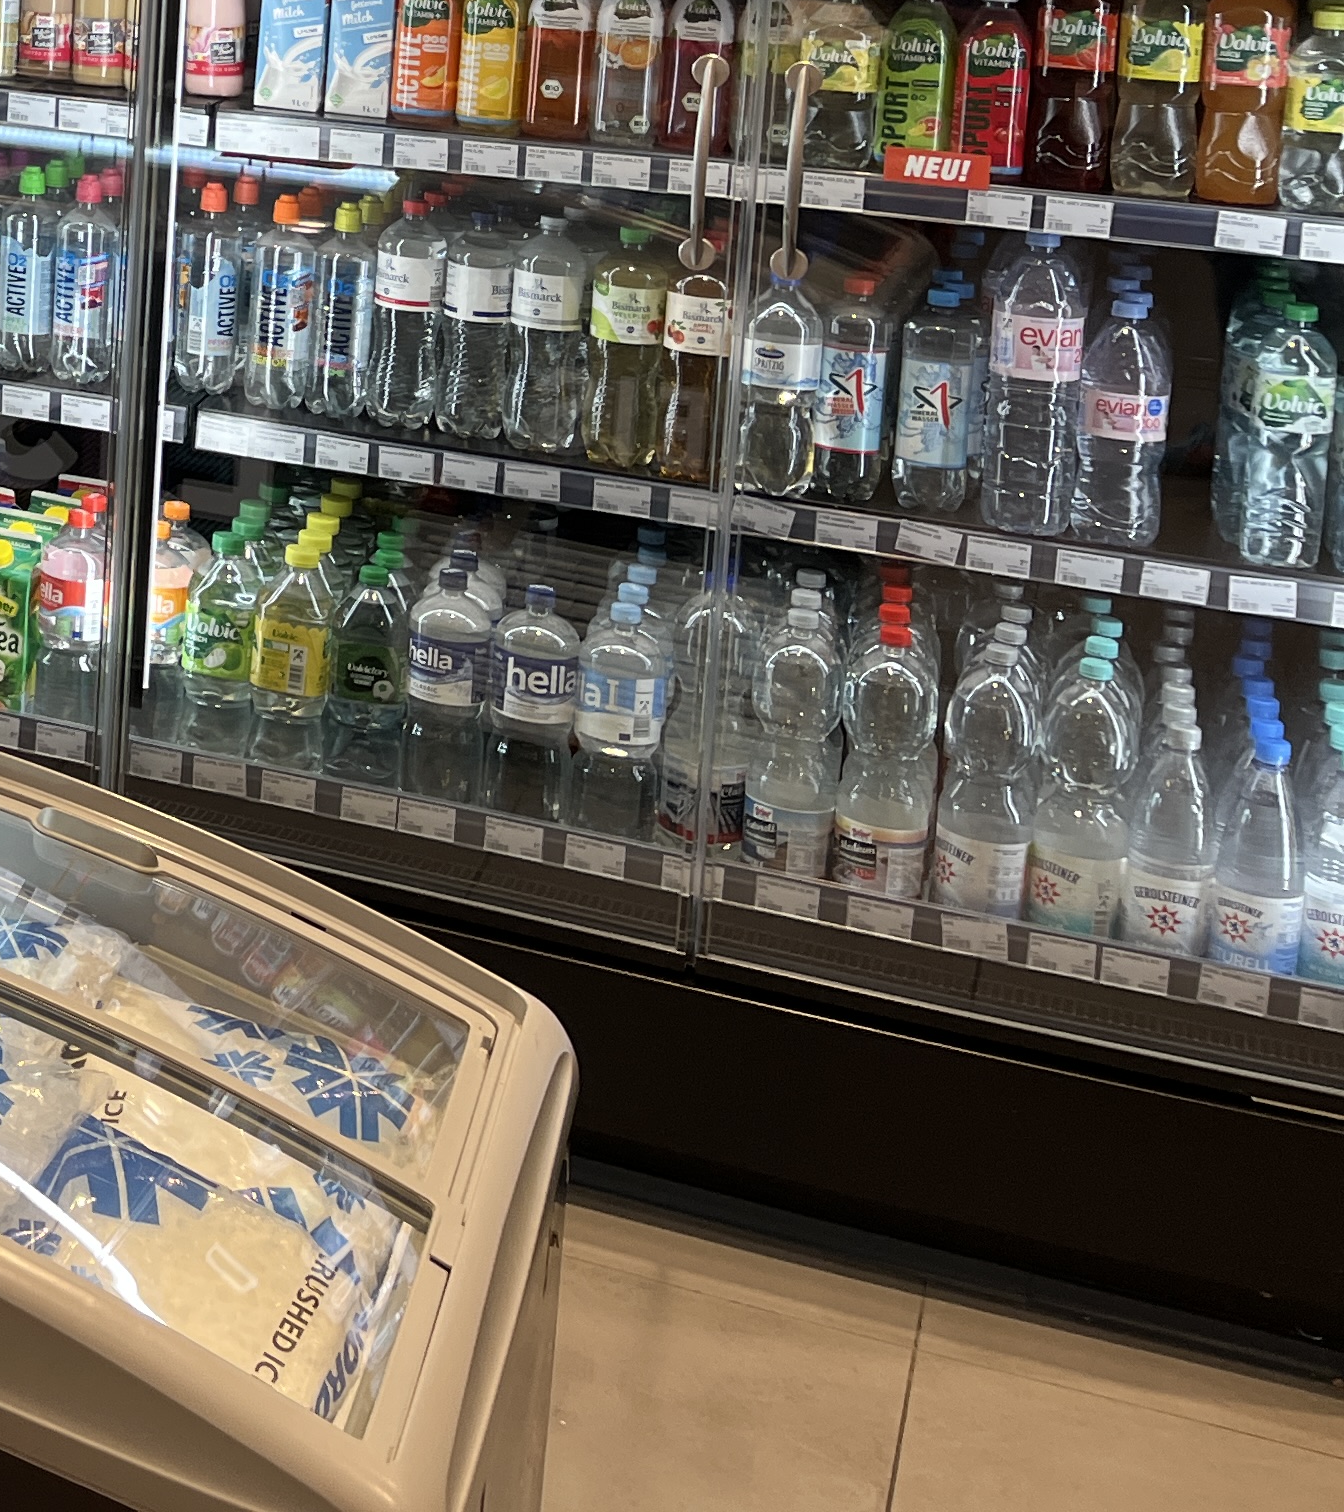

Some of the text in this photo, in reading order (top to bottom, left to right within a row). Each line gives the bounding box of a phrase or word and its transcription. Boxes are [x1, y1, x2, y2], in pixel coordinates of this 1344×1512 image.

[272, 6, 305, 19] Milch
[342, 11, 373, 25] Milch
[1051, 17, 1106, 36] Volvic
[891, 37, 939, 54] Volvic
[972, 39, 1024, 58] Volvic
[1132, 28, 1187, 48] Volvic
[1220, 34, 1276, 52] Volvic
[812, 48, 855, 64] Volvic
[893, 53, 924, 63] VITAMIN
[973, 59, 1010, 68] VITAMIN
[396, 31, 421, 106] ACTIVE
[903, 154, 972, 182] NEU!
[6, 266, 27, 316] ACTIVE
[55, 261, 76, 323] ACTIVE
[518, 287, 562, 302] Bismarck
[217, 287, 236, 337] ACTIVE
[612, 301, 651, 312] Bismarck
[683, 310, 723, 322] Bismarck
[1020, 324, 1081, 347] evian
[1096, 398, 1148, 416] evian
[1261, 393, 1325, 416] Volvic
[41, 581, 63, 604] ella
[409, 640, 453, 671] hella
[506, 658, 577, 696] hella
[1134, 886, 1200, 908] GEROLSTEINER
[101, 1088, 129, 1124] ICE
[272, 1253, 340, 1354] RUSHED
[254, 1351, 285, 1384] IC
